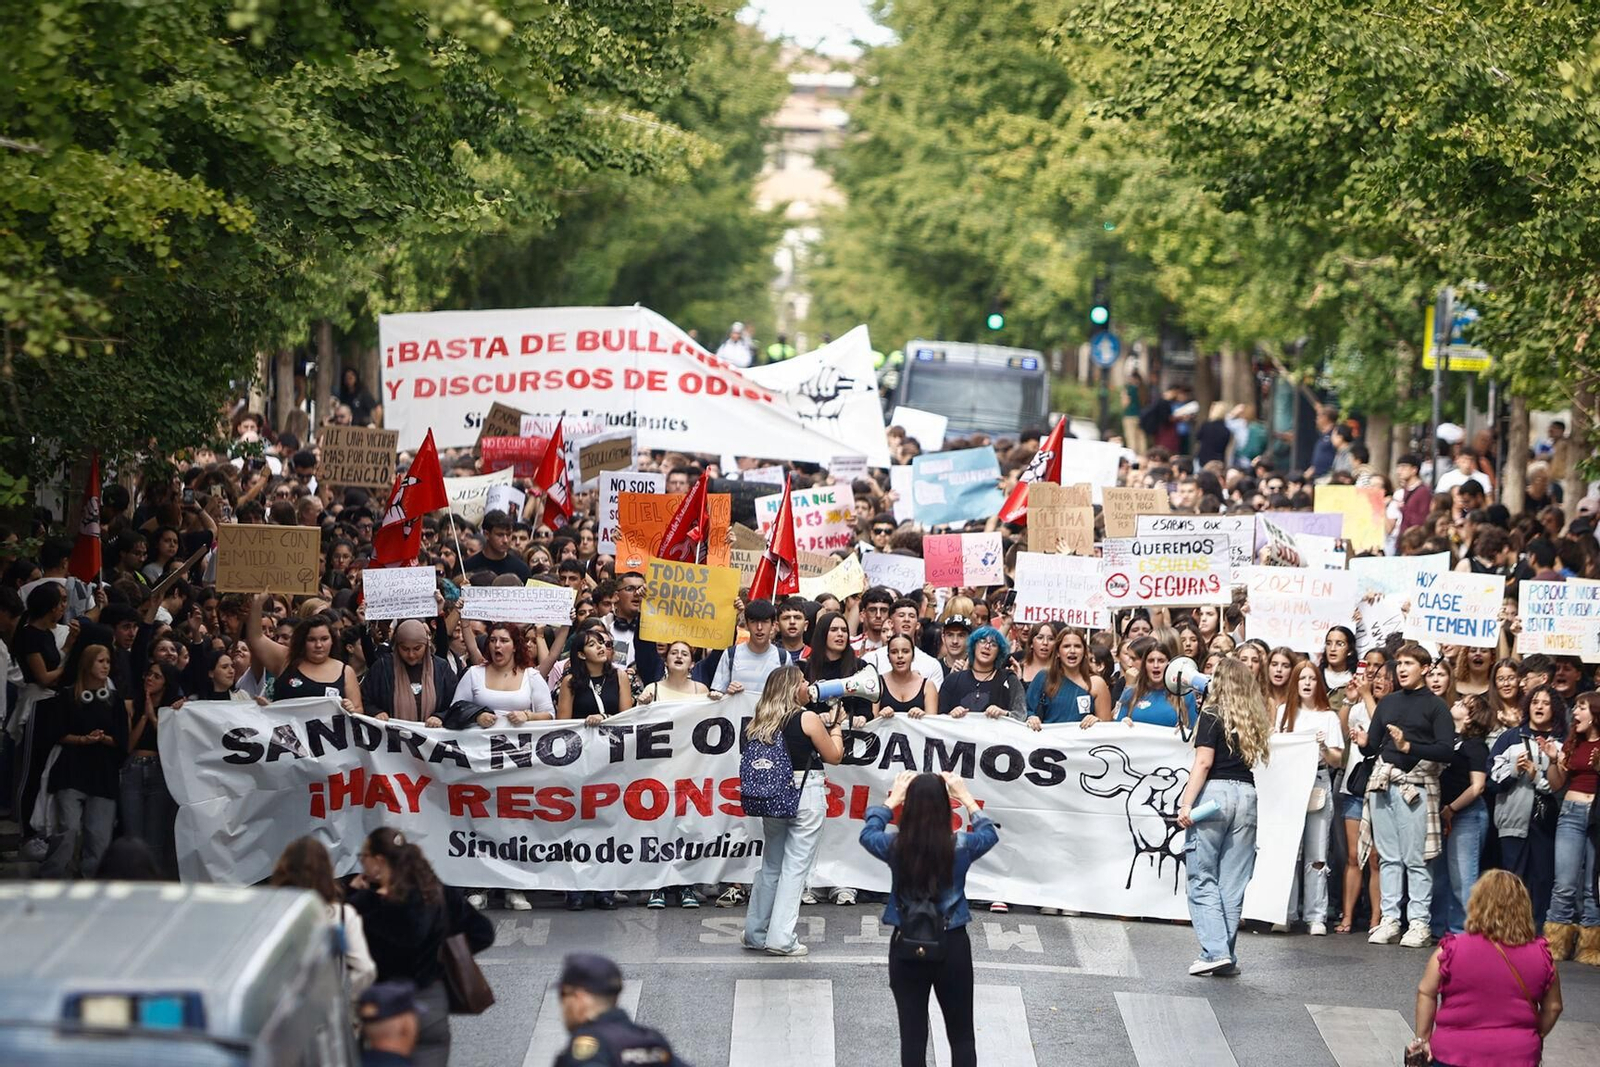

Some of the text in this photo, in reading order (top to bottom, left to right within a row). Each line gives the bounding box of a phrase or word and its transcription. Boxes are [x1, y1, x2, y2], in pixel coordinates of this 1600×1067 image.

[387, 336, 509, 368] ¡BASTA
[520, 332, 567, 355] DE
[385, 378, 404, 401] Y
[413, 368, 613, 399] DISCURSOS
[623, 369, 668, 391] DE
[583, 410, 689, 432] tudiantes
[325, 429, 341, 446] NI
[346, 431, 364, 447] UNA
[323, 449, 391, 466] MAS POR CULPA
[610, 478, 655, 493] NO SOIS
[767, 492, 836, 513] HTA QUE
[806, 511, 822, 526] ES
[222, 529, 310, 549] VIVIR CON
[1132, 538, 1214, 556] QUEREMOS
[232, 549, 305, 567] MIEDO NO
[953, 555, 967, 564] NO
[1139, 556, 1209, 573] ESCUELAS
[227, 570, 293, 586] ES VIVIR
[650, 563, 709, 584] TODOS
[1416, 571, 1438, 588] HOY
[648, 580, 707, 603] SOMOS
[1136, 574, 1220, 599] SEGURAS
[1254, 573, 1333, 597] 2024 EN
[1528, 584, 1569, 600] PORQUE
[646, 597, 716, 620] SANDRA
[1417, 592, 1463, 613] CLASE
[1527, 602, 1555, 615] NUNCA
[1024, 606, 1100, 626] MISERABLE
[1526, 617, 1555, 632] SENTIR
[1424, 615, 1477, 637] TEMEN
[1481, 619, 1497, 638] IR
[221, 714, 1067, 786] SANDRA NO TE ODAMOS
[308, 766, 986, 833] ¡HAY RESPONSBLS
[448, 830, 764, 864] Sindicato de Estudian
[699, 915, 1044, 953] MTOS
